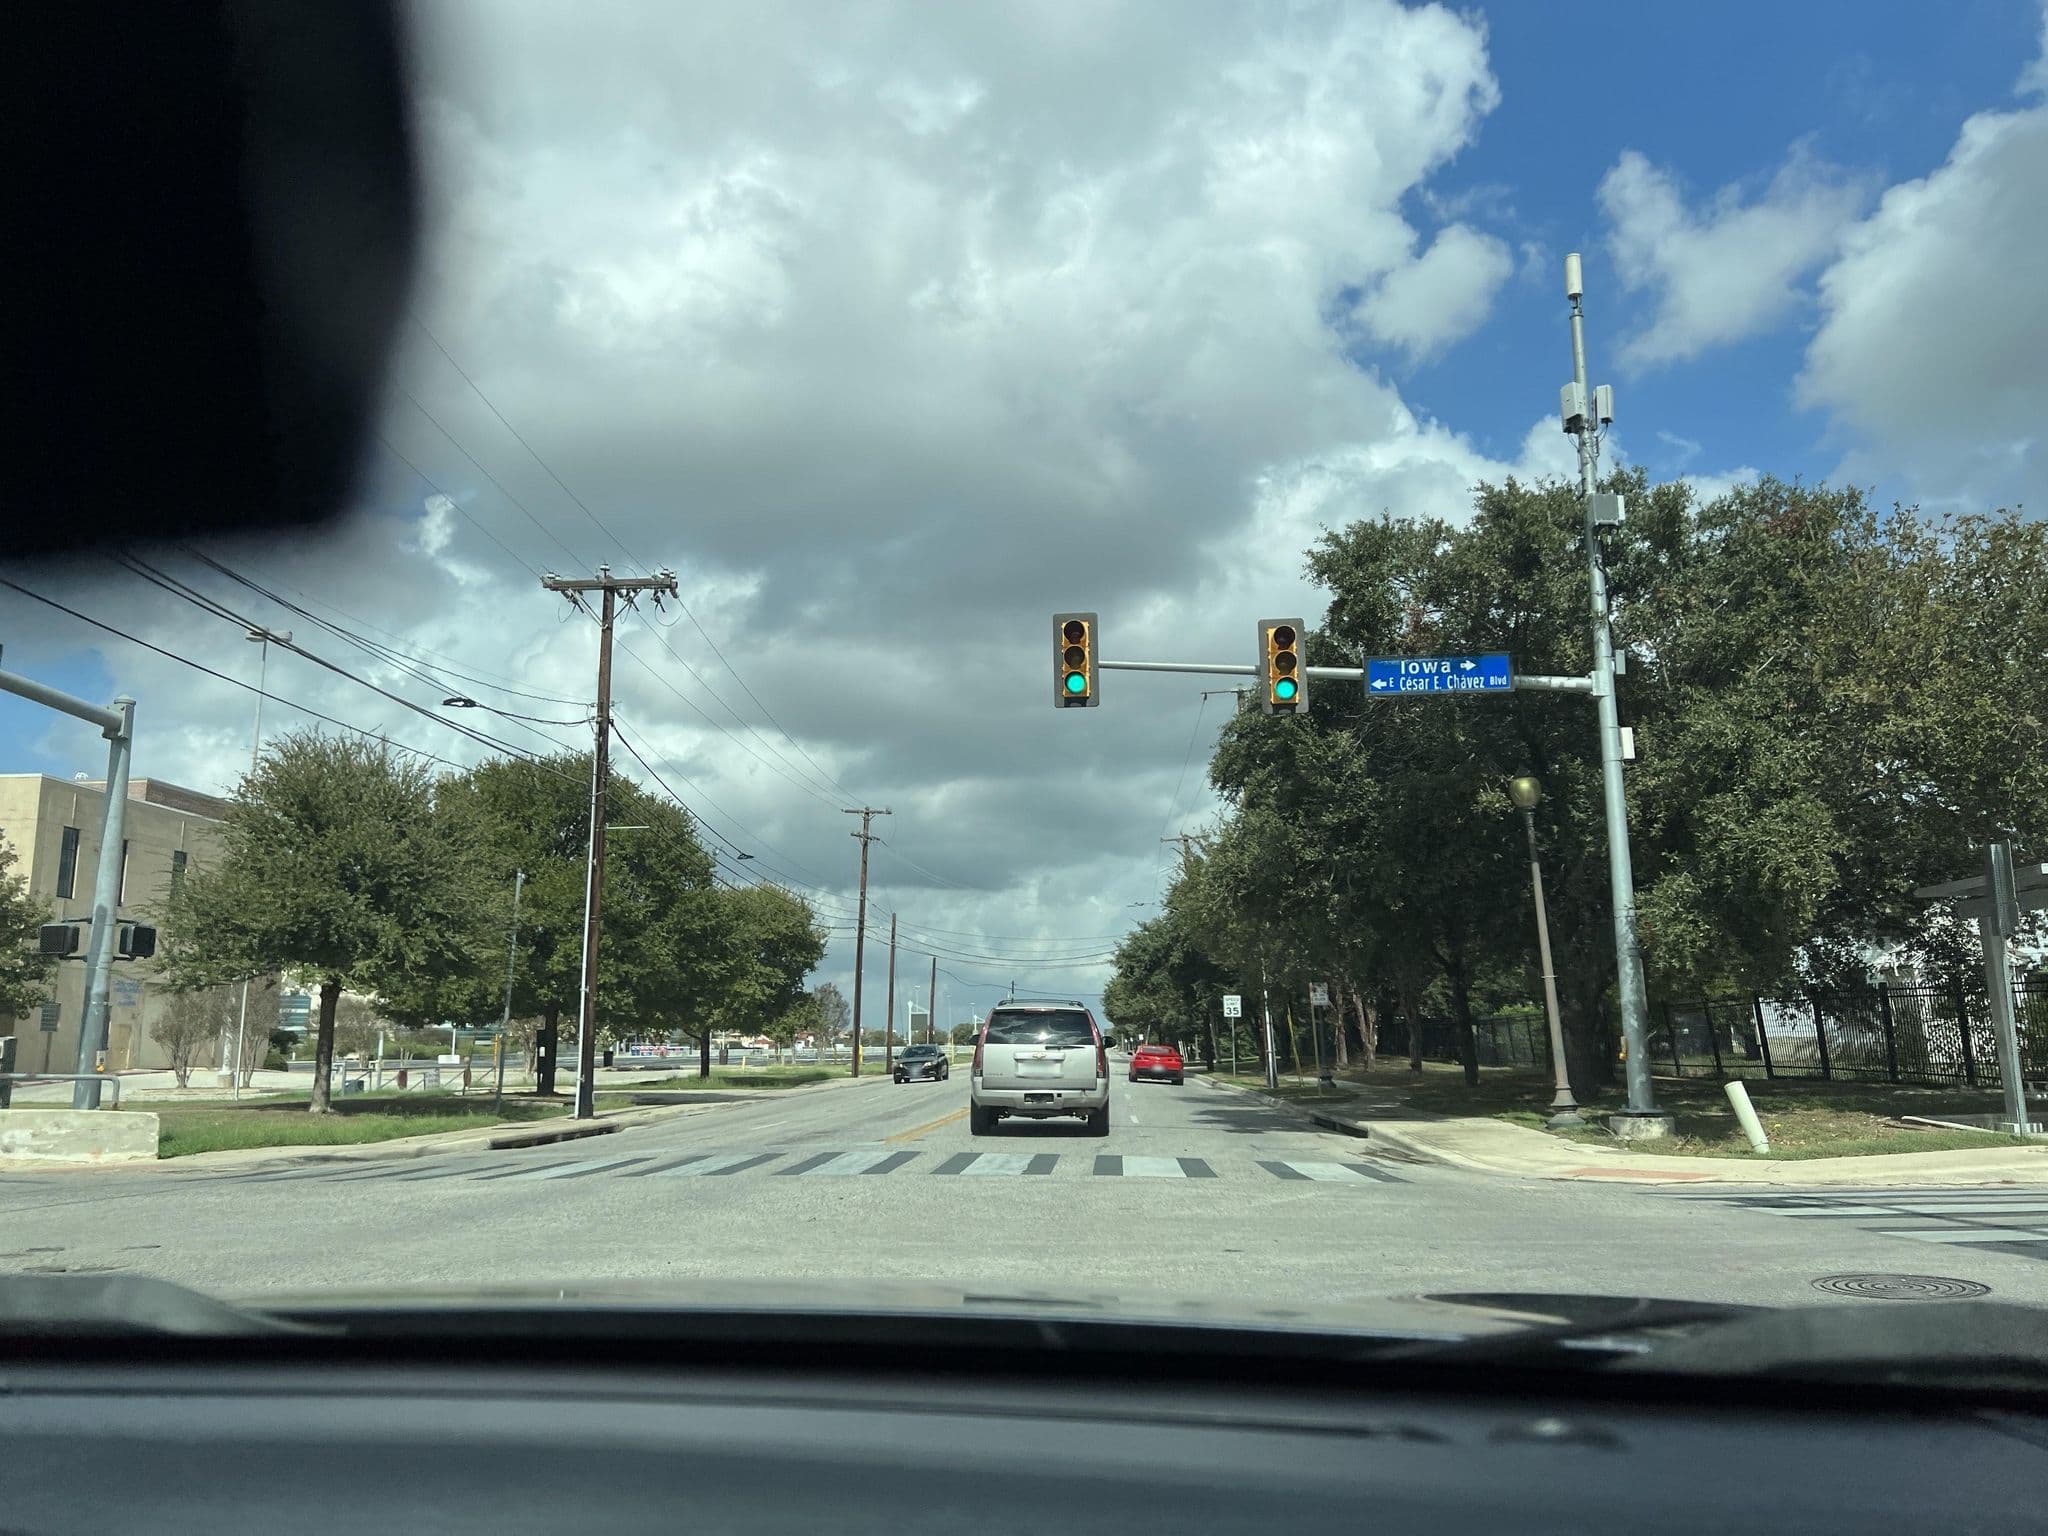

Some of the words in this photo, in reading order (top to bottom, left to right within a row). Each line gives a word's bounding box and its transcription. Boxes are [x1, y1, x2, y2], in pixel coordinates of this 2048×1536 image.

[1401, 660, 1451, 674] Iowa
[1389, 677, 1394, 687] E
[1399, 675, 1430, 690] César
[1434, 676, 1442, 690] E.
[1447, 674, 1484, 689] Chávez
[1489, 675, 1507, 685] Blvd
[1226, 1007, 1239, 1015] 35
